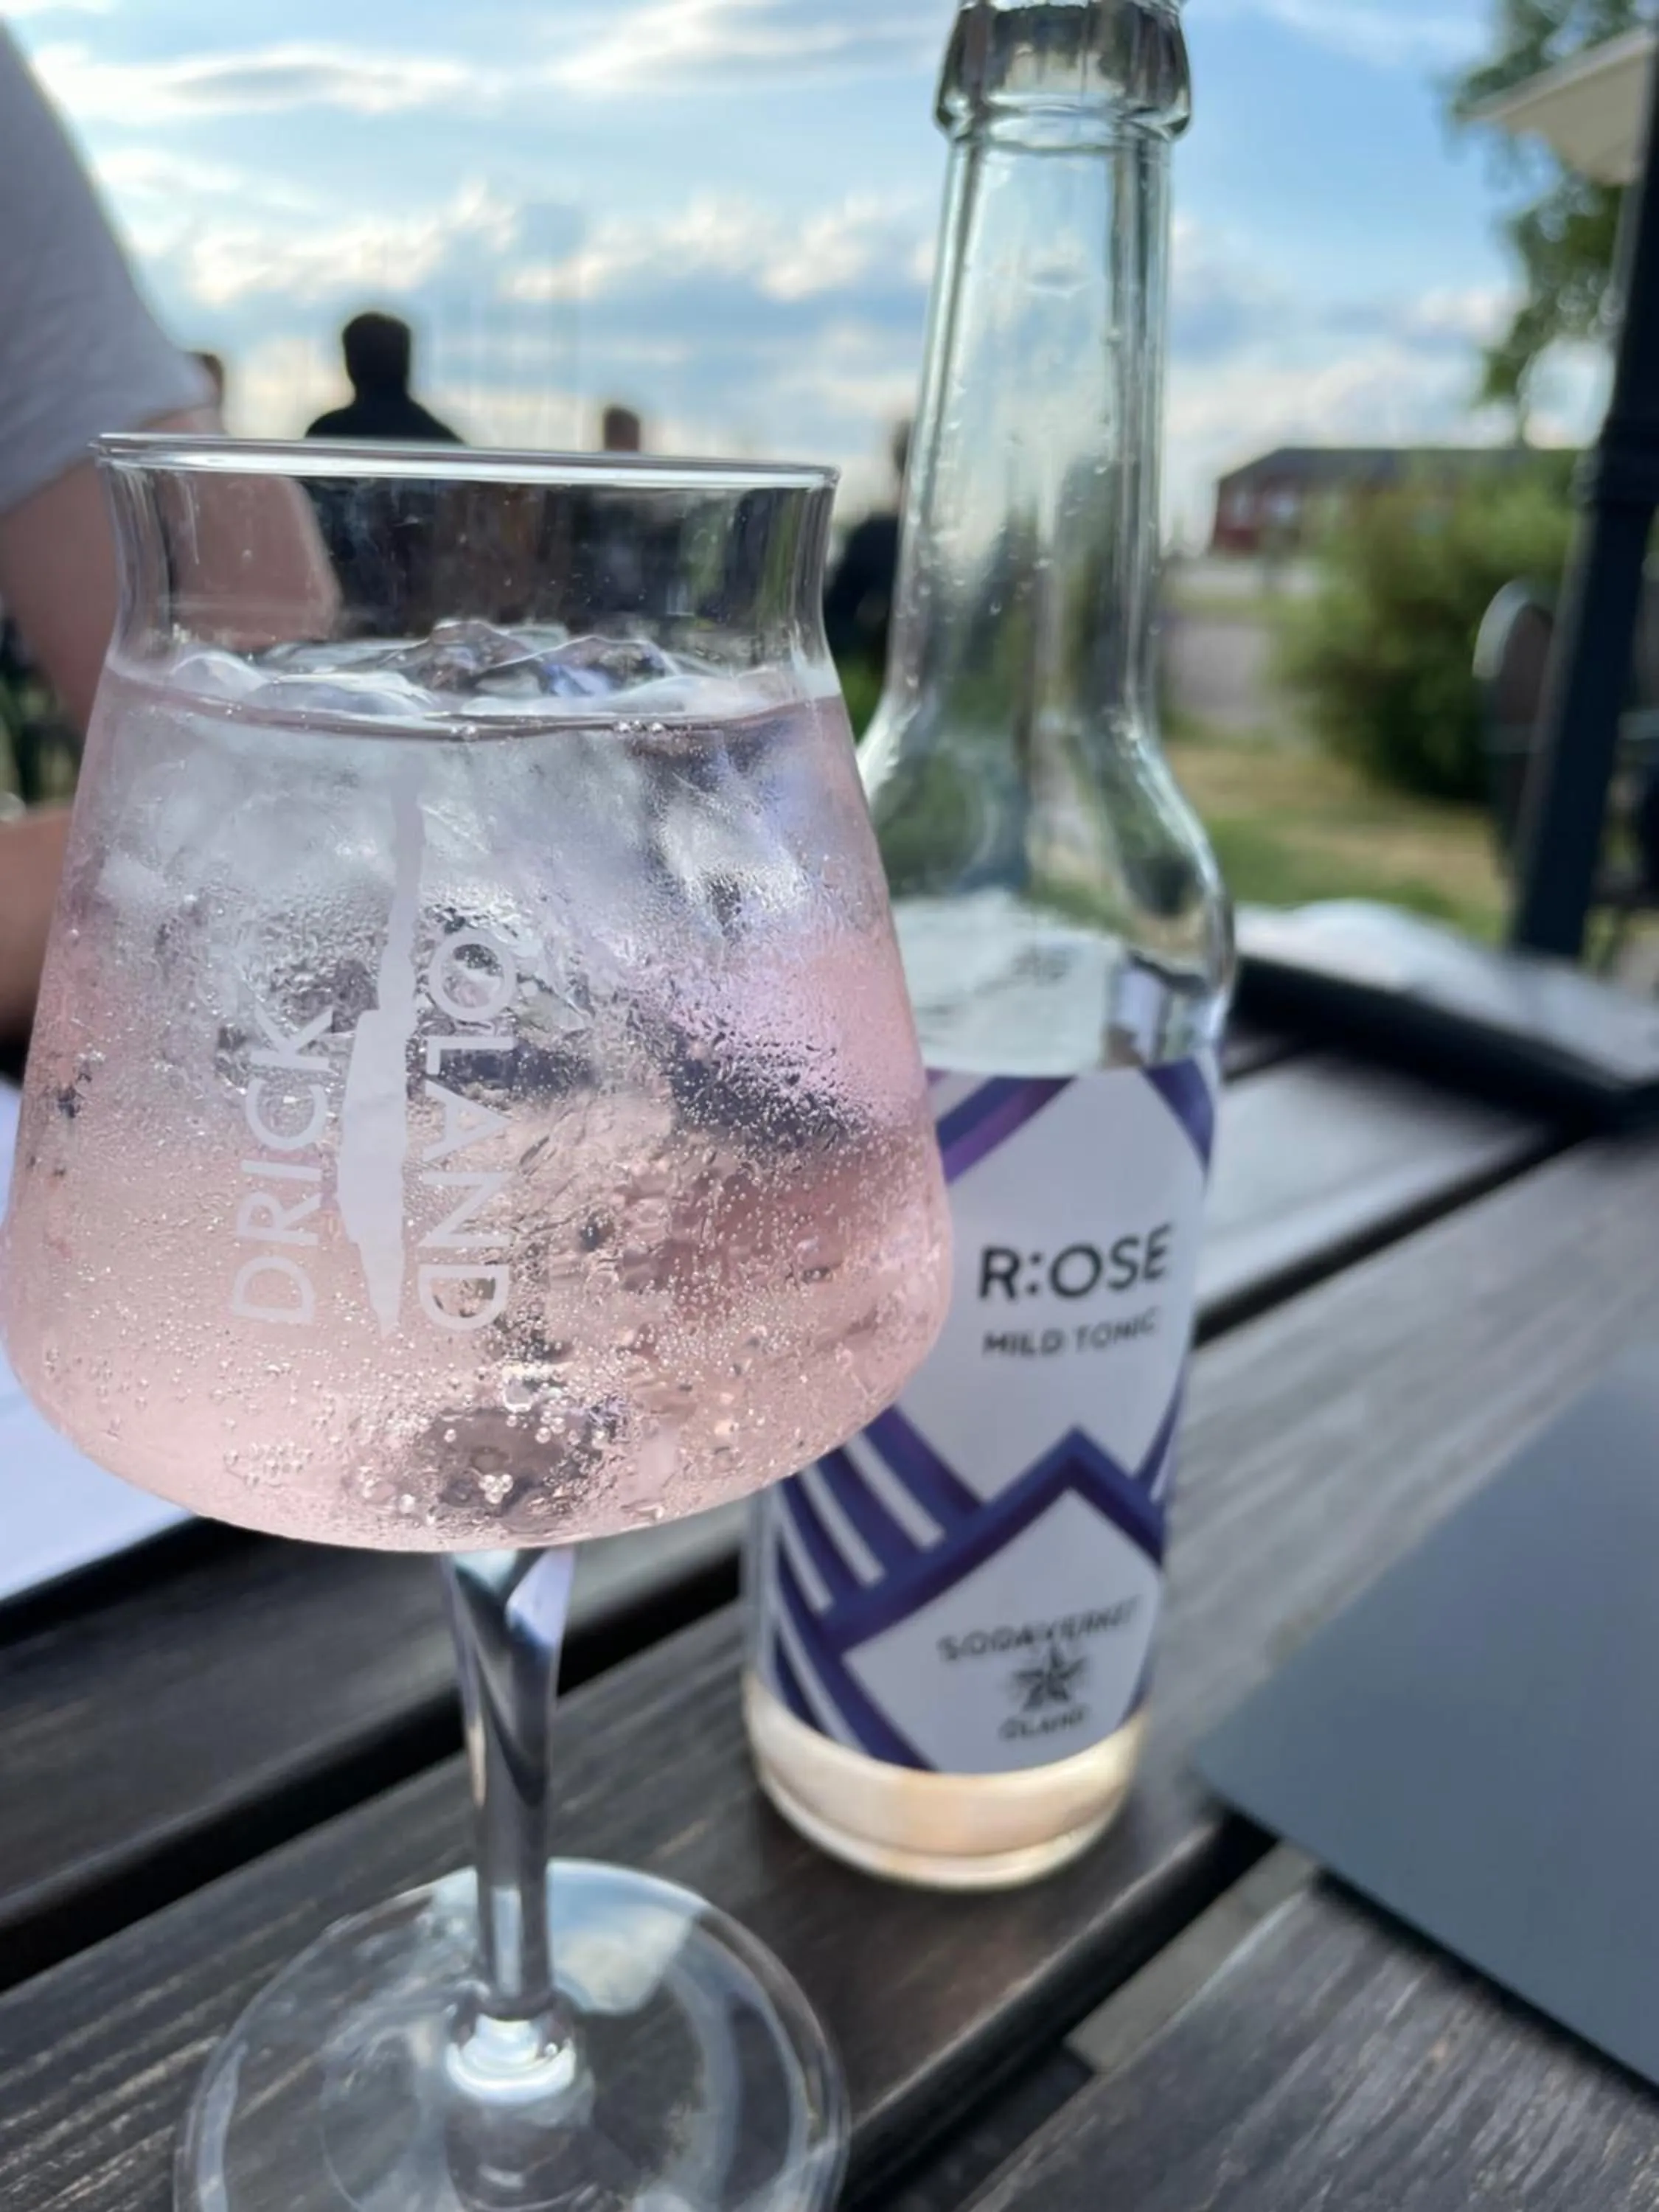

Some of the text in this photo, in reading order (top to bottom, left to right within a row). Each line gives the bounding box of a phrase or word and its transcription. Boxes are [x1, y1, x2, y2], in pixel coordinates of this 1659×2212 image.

[231, 1007, 333, 1324] DRICK
[978, 1222, 1172, 1300] R:OSE
[983, 1307, 1160, 1357] MILD TONIC
